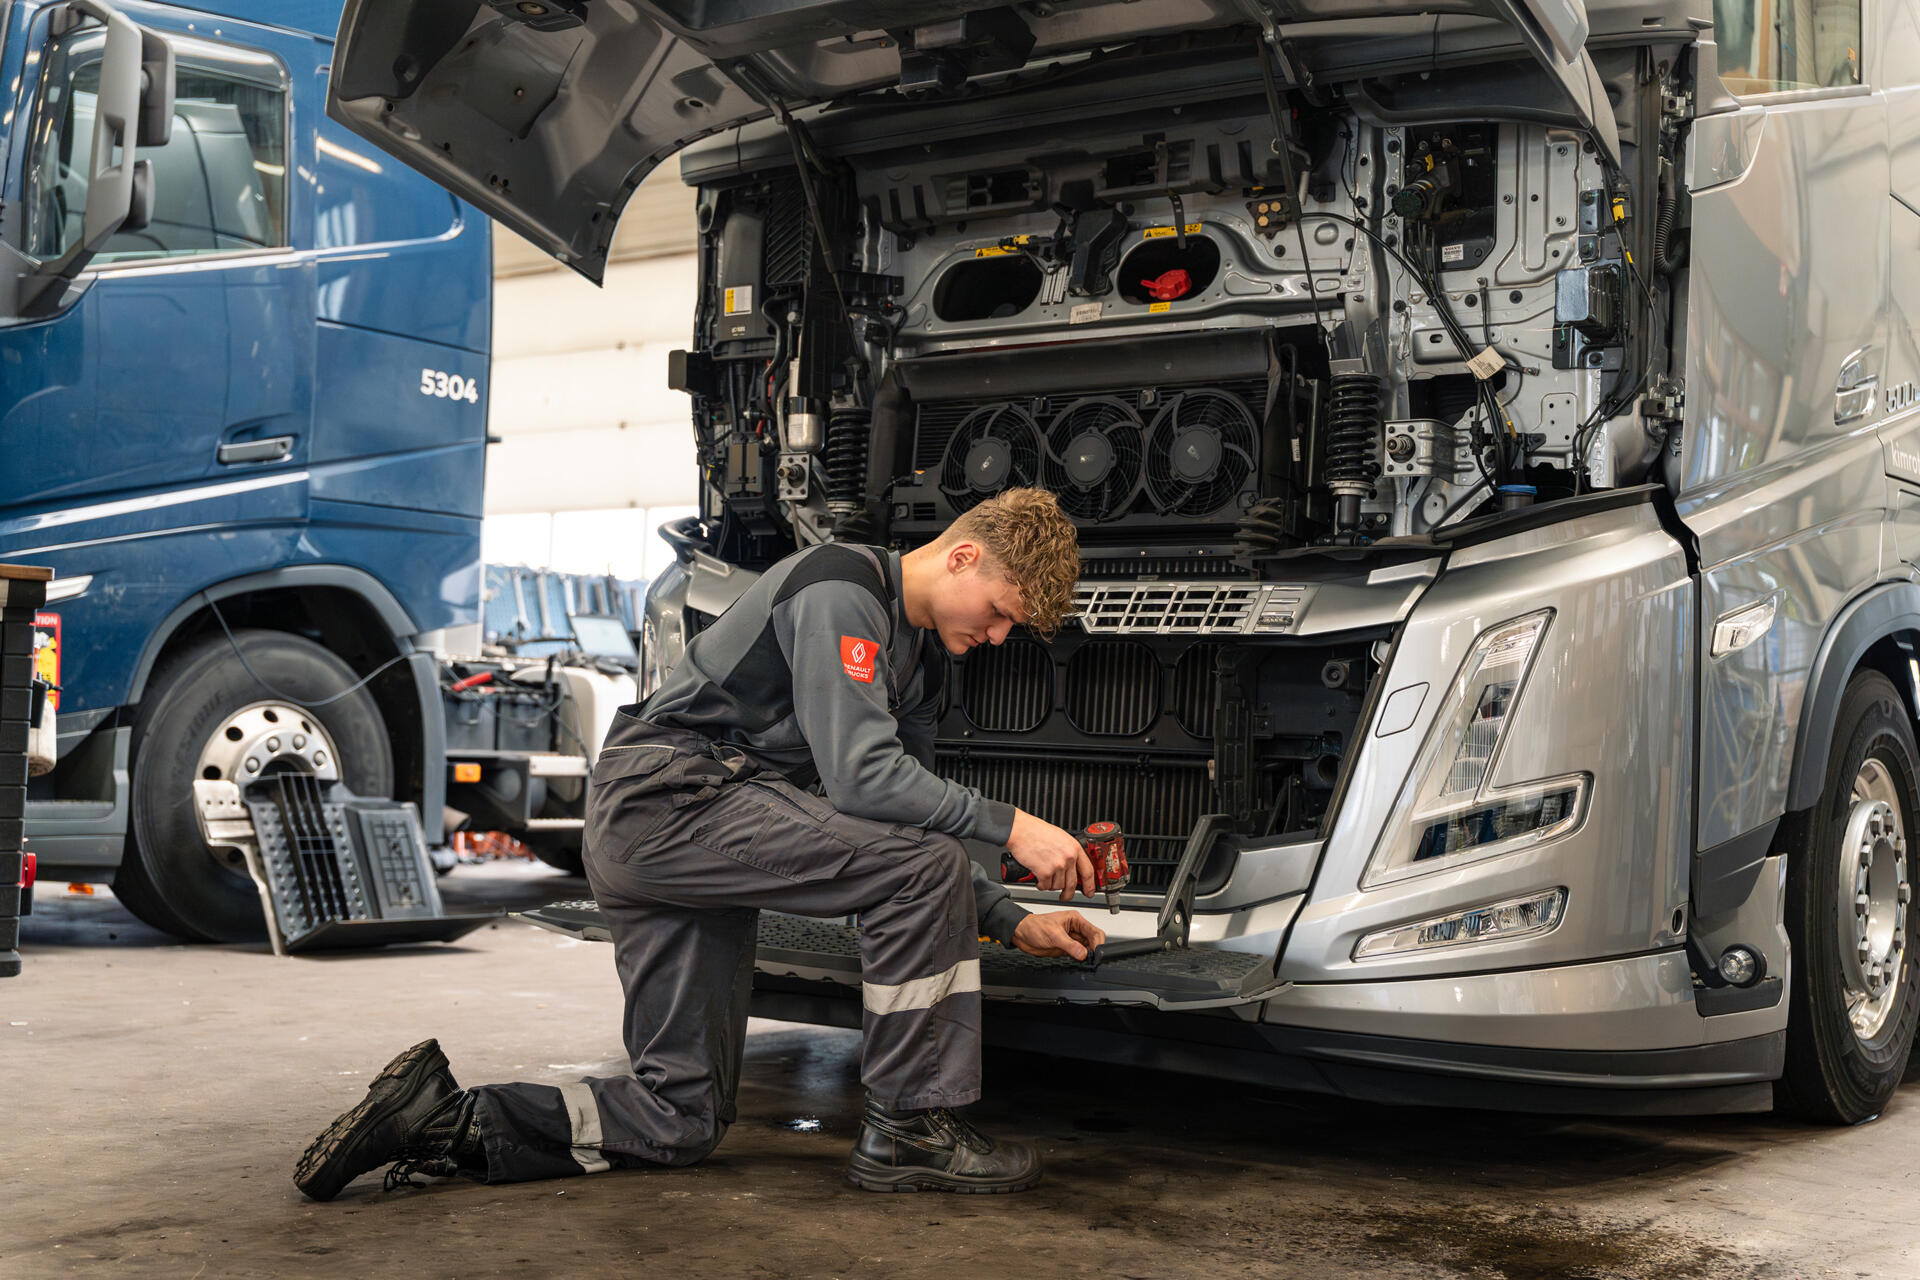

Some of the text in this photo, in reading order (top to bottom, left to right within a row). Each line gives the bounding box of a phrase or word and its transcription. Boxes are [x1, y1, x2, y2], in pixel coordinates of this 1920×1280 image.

[420, 368, 479, 404] 5304
[1885, 381, 1920, 413] 500
[36, 615, 58, 626] TION
